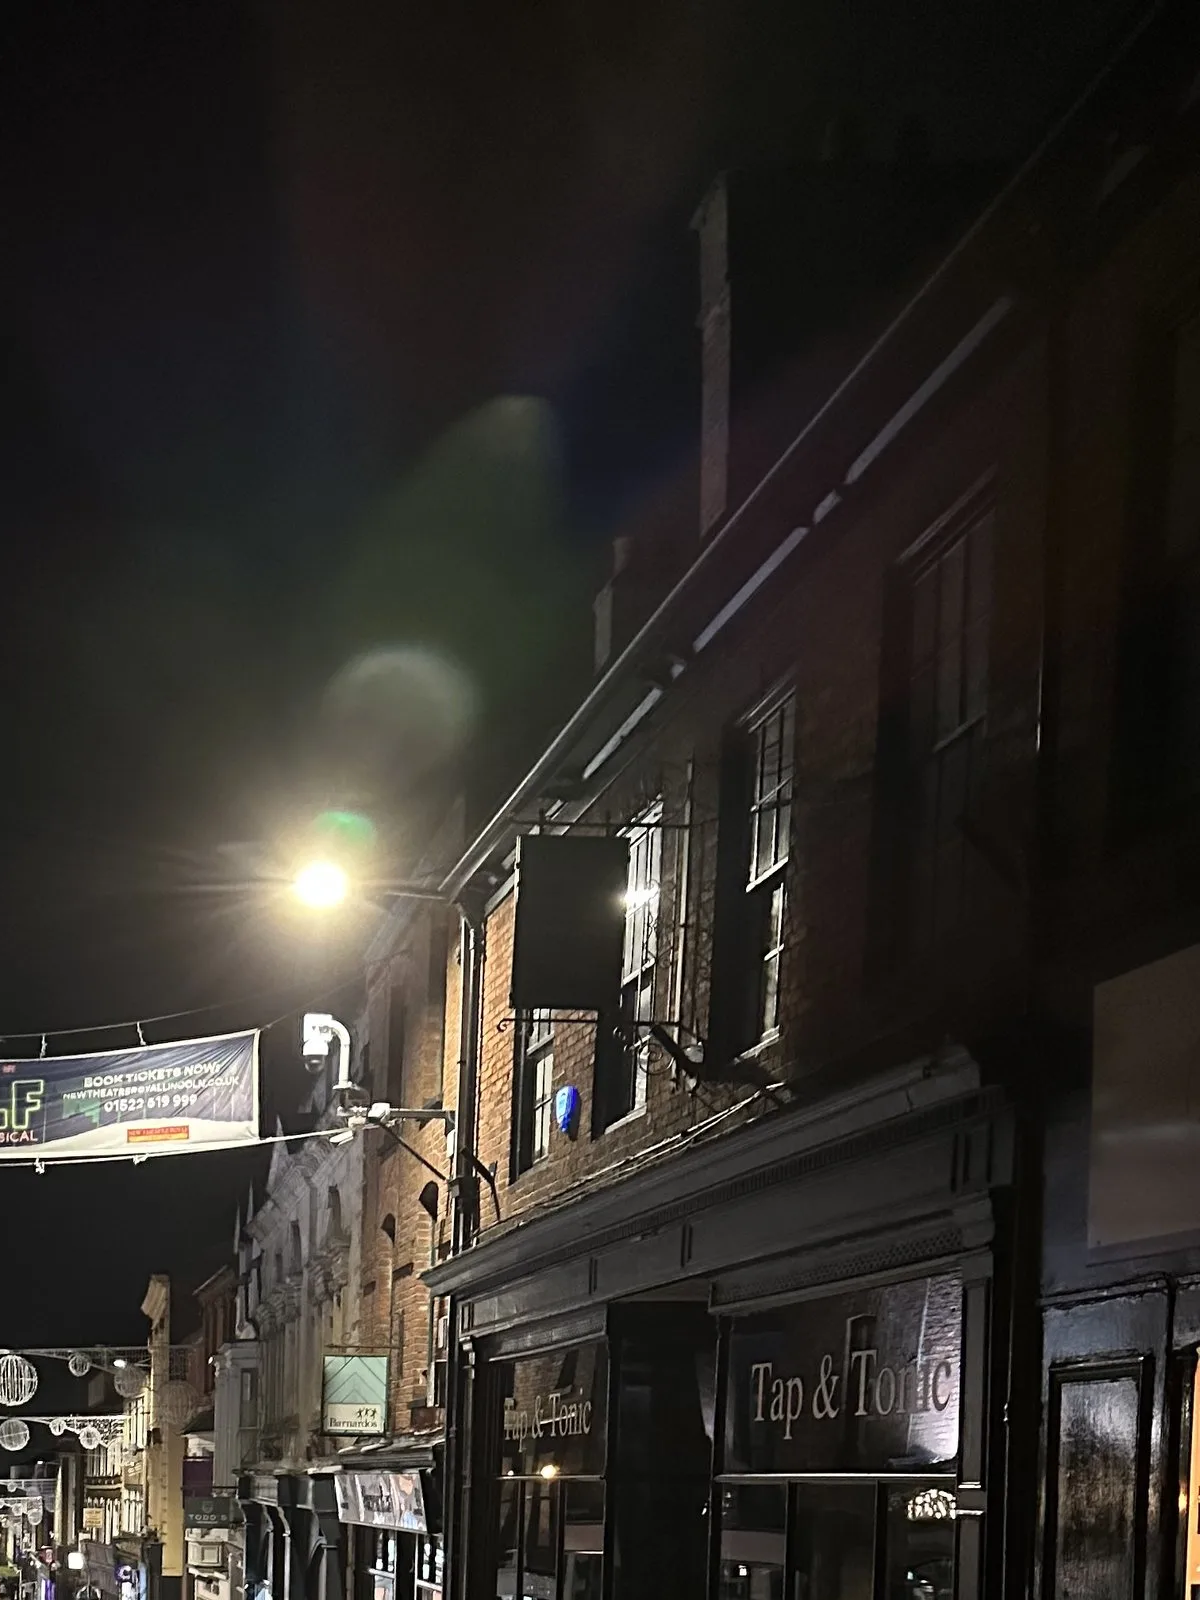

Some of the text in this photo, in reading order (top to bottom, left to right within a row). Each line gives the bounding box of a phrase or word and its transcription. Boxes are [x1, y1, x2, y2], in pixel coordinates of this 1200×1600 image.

[84, 1075, 123, 1088] BOOK
[126, 1066, 181, 1083] TICKETS
[172, 1093, 197, 1107] 999
[751, 1349, 953, 1440] Tap & Tonic
[504, 1387, 592, 1453] Tap & Tonic
